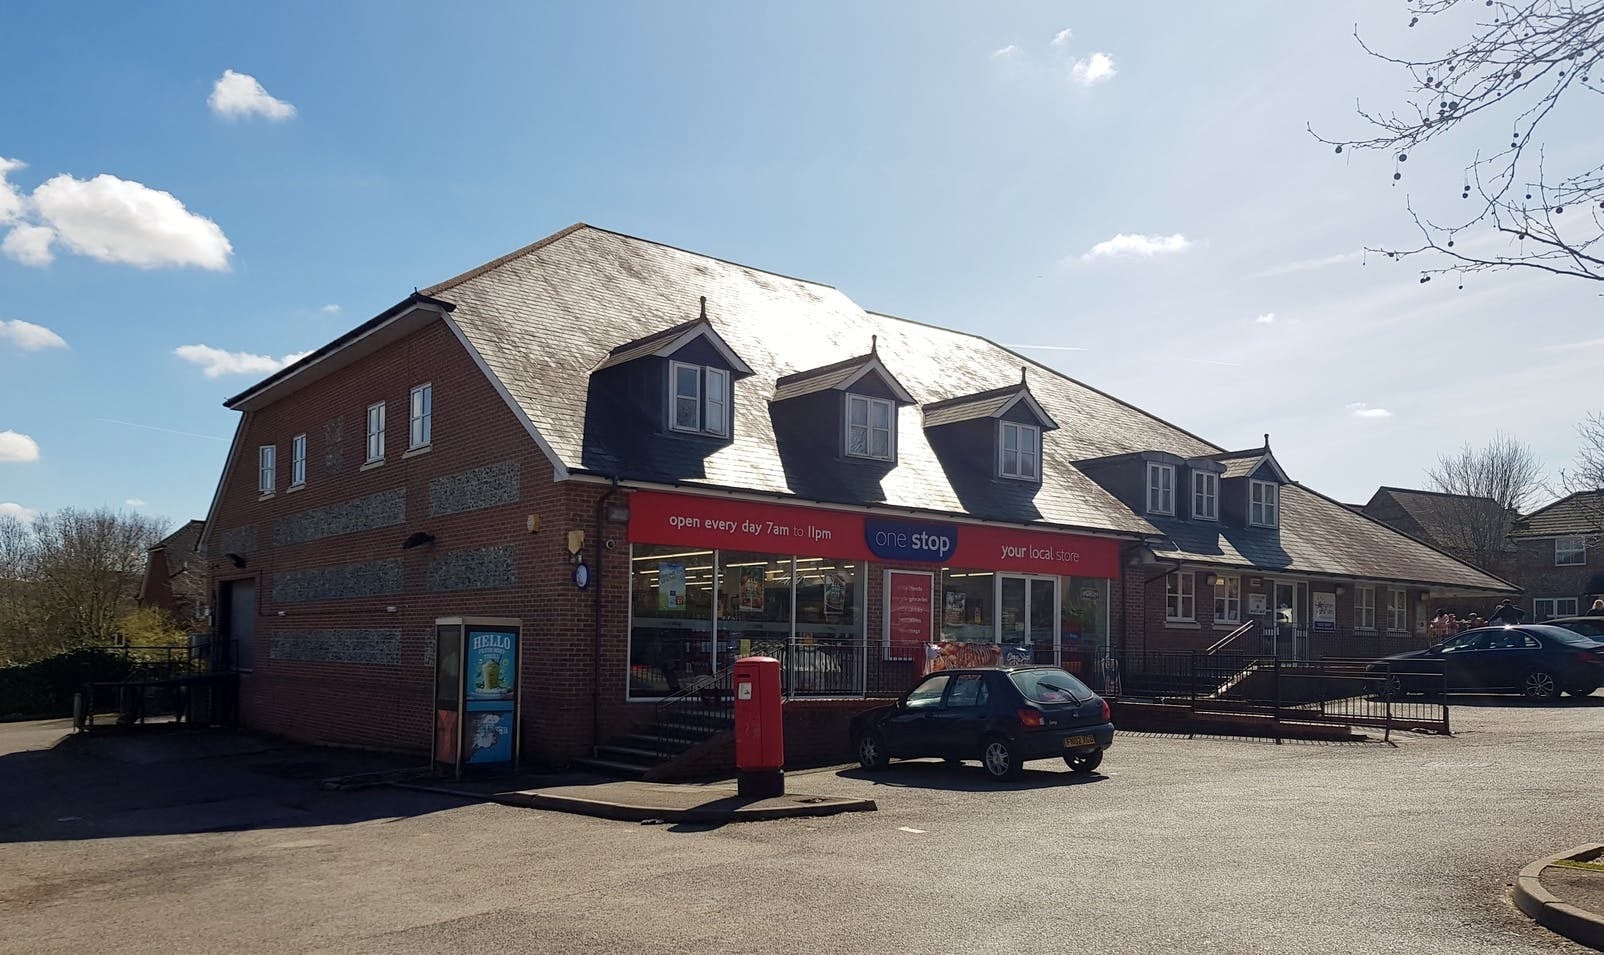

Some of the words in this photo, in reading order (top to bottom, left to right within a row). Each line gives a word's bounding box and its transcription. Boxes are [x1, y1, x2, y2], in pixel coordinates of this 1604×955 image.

[669, 515, 700, 529] open
[705, 518, 737, 533] every
[742, 519, 763, 536] day
[766, 521, 789, 536] 7am
[793, 526, 804, 537] to
[808, 525, 832, 541] 11pm
[875, 531, 907, 548] one
[912, 531, 950, 557] stop
[1001, 544, 1027, 560] your
[1029, 544, 1054, 560] local
[1056, 549, 1080, 562] store
[473, 634, 511, 650] HELLO
